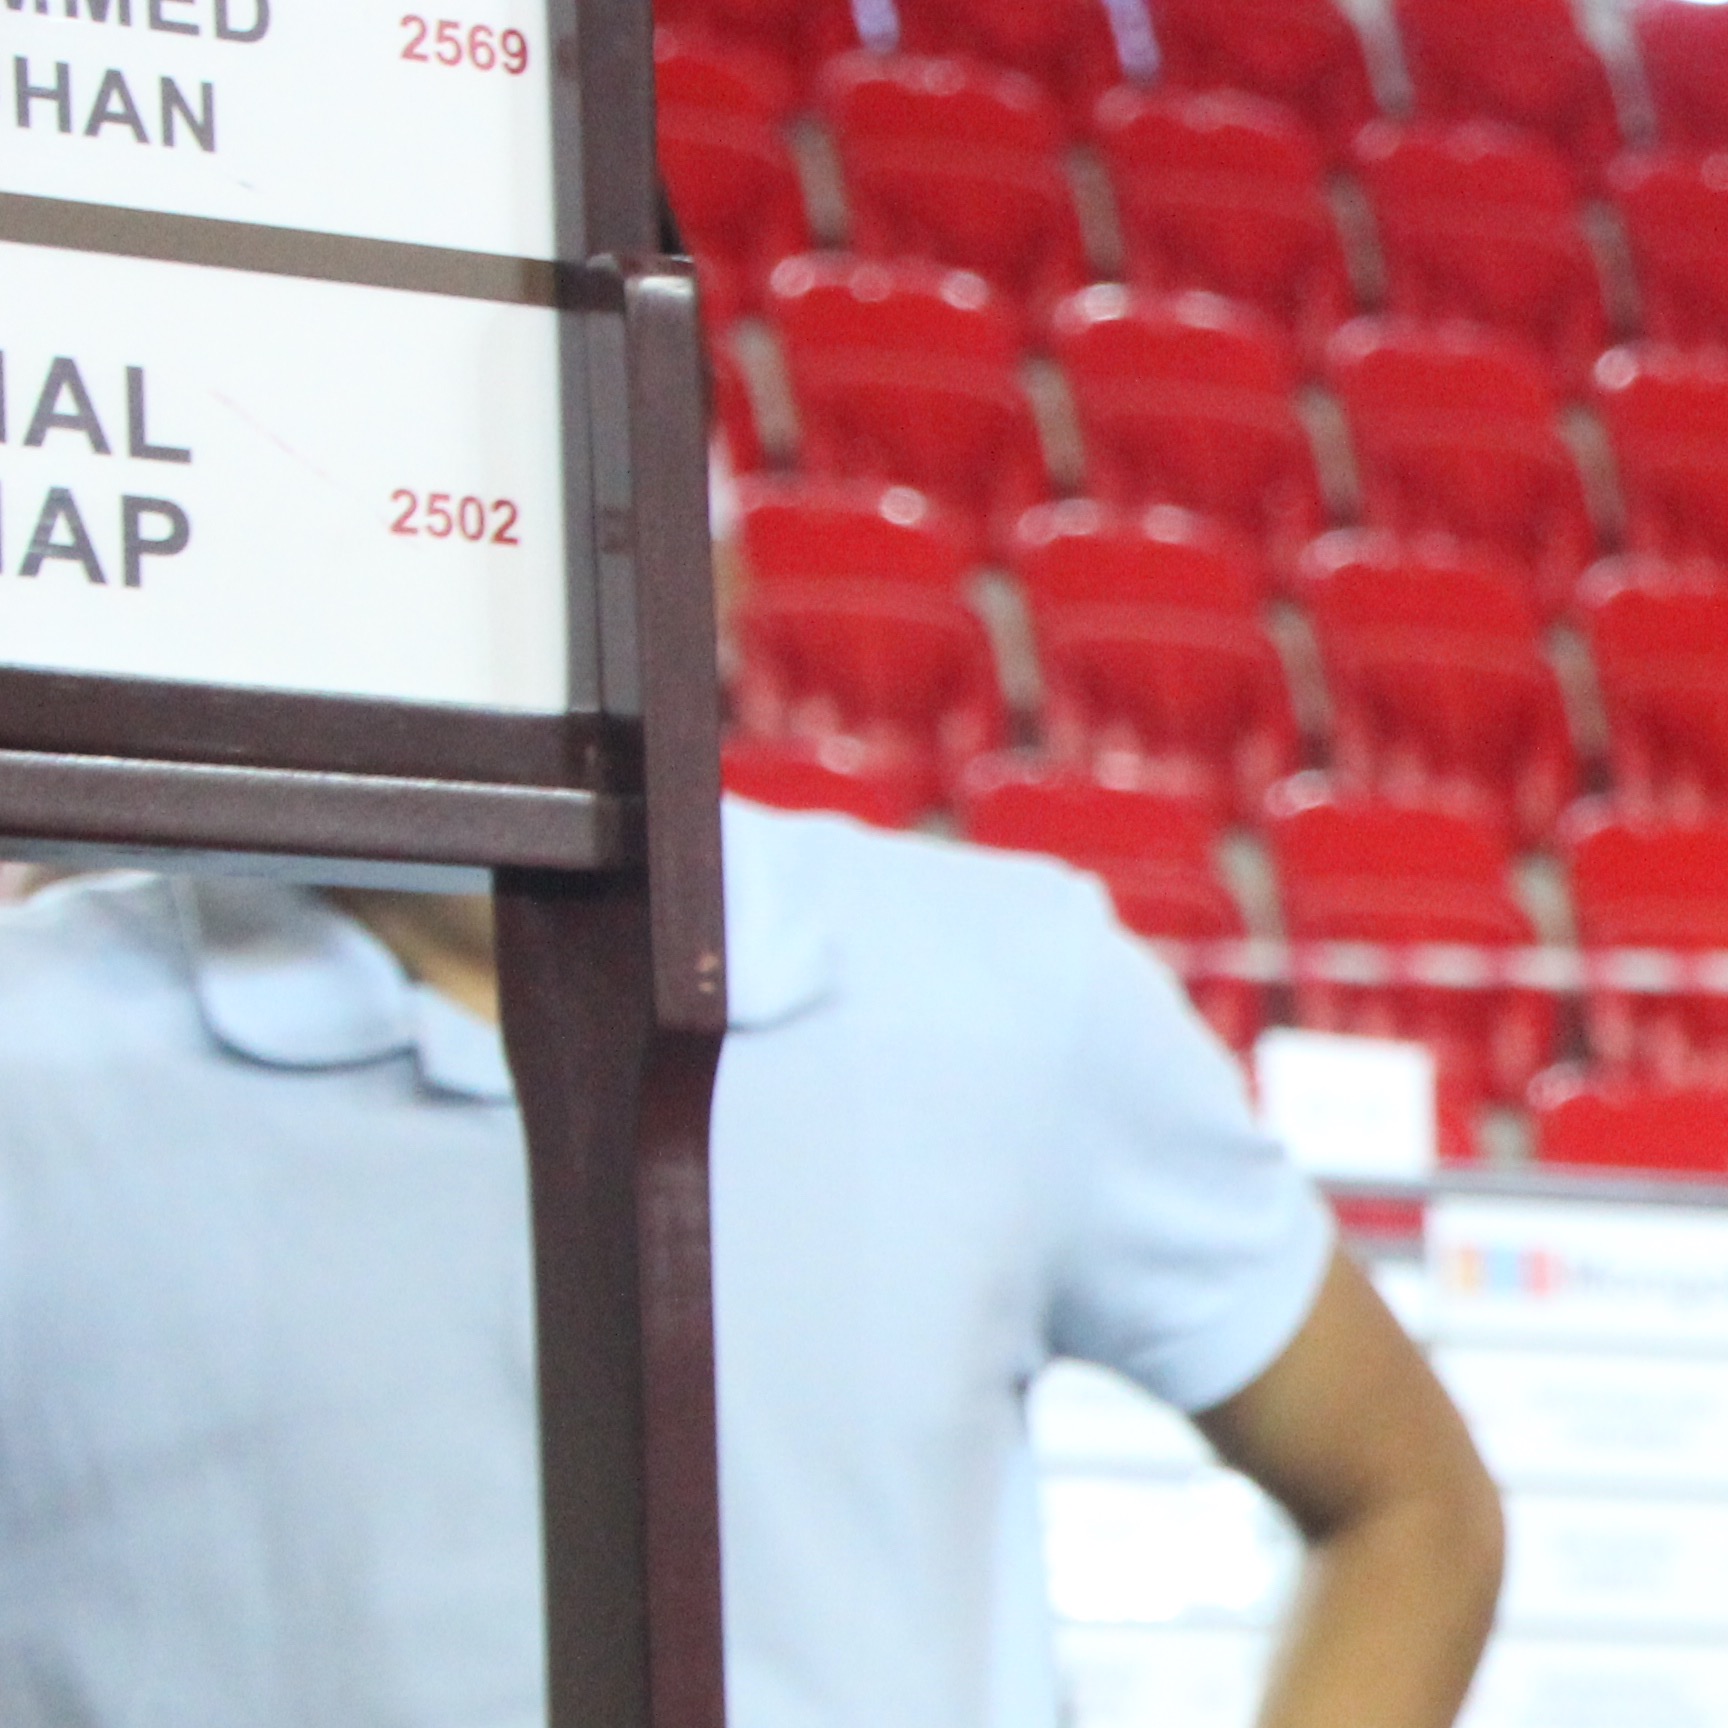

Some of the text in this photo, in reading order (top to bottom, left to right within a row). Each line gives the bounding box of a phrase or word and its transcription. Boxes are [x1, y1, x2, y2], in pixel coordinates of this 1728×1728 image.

[399, 14, 529, 76] 2569
[14, 54, 216, 153] HAN
[0, 346, 192, 464] AL
[0, 482, 191, 588] AP
[390, 488, 520, 546] 2502
